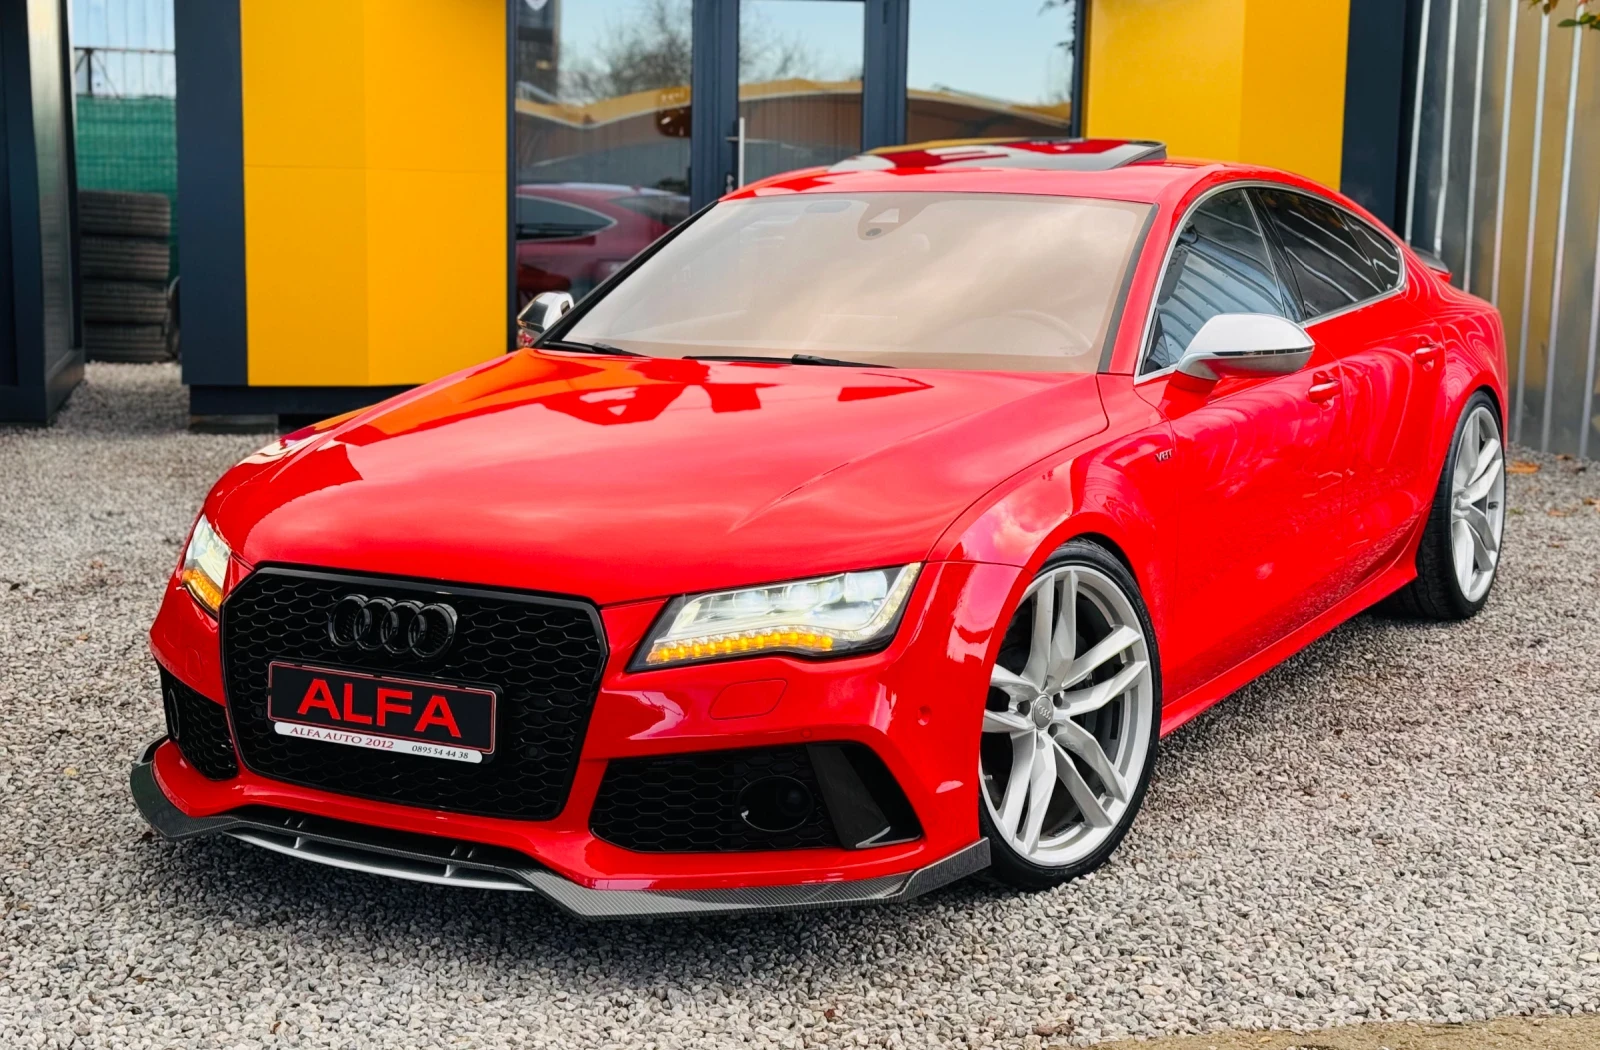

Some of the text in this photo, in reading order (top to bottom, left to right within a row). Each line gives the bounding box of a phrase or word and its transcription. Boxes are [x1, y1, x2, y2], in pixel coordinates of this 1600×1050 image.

[297, 678, 462, 738] ALFA
[290, 727, 394, 749] ALFA AUTO 2012
[411, 745, 432, 754] 0895
[433, 748, 443, 756] 54
[458, 751, 469, 759] 38
